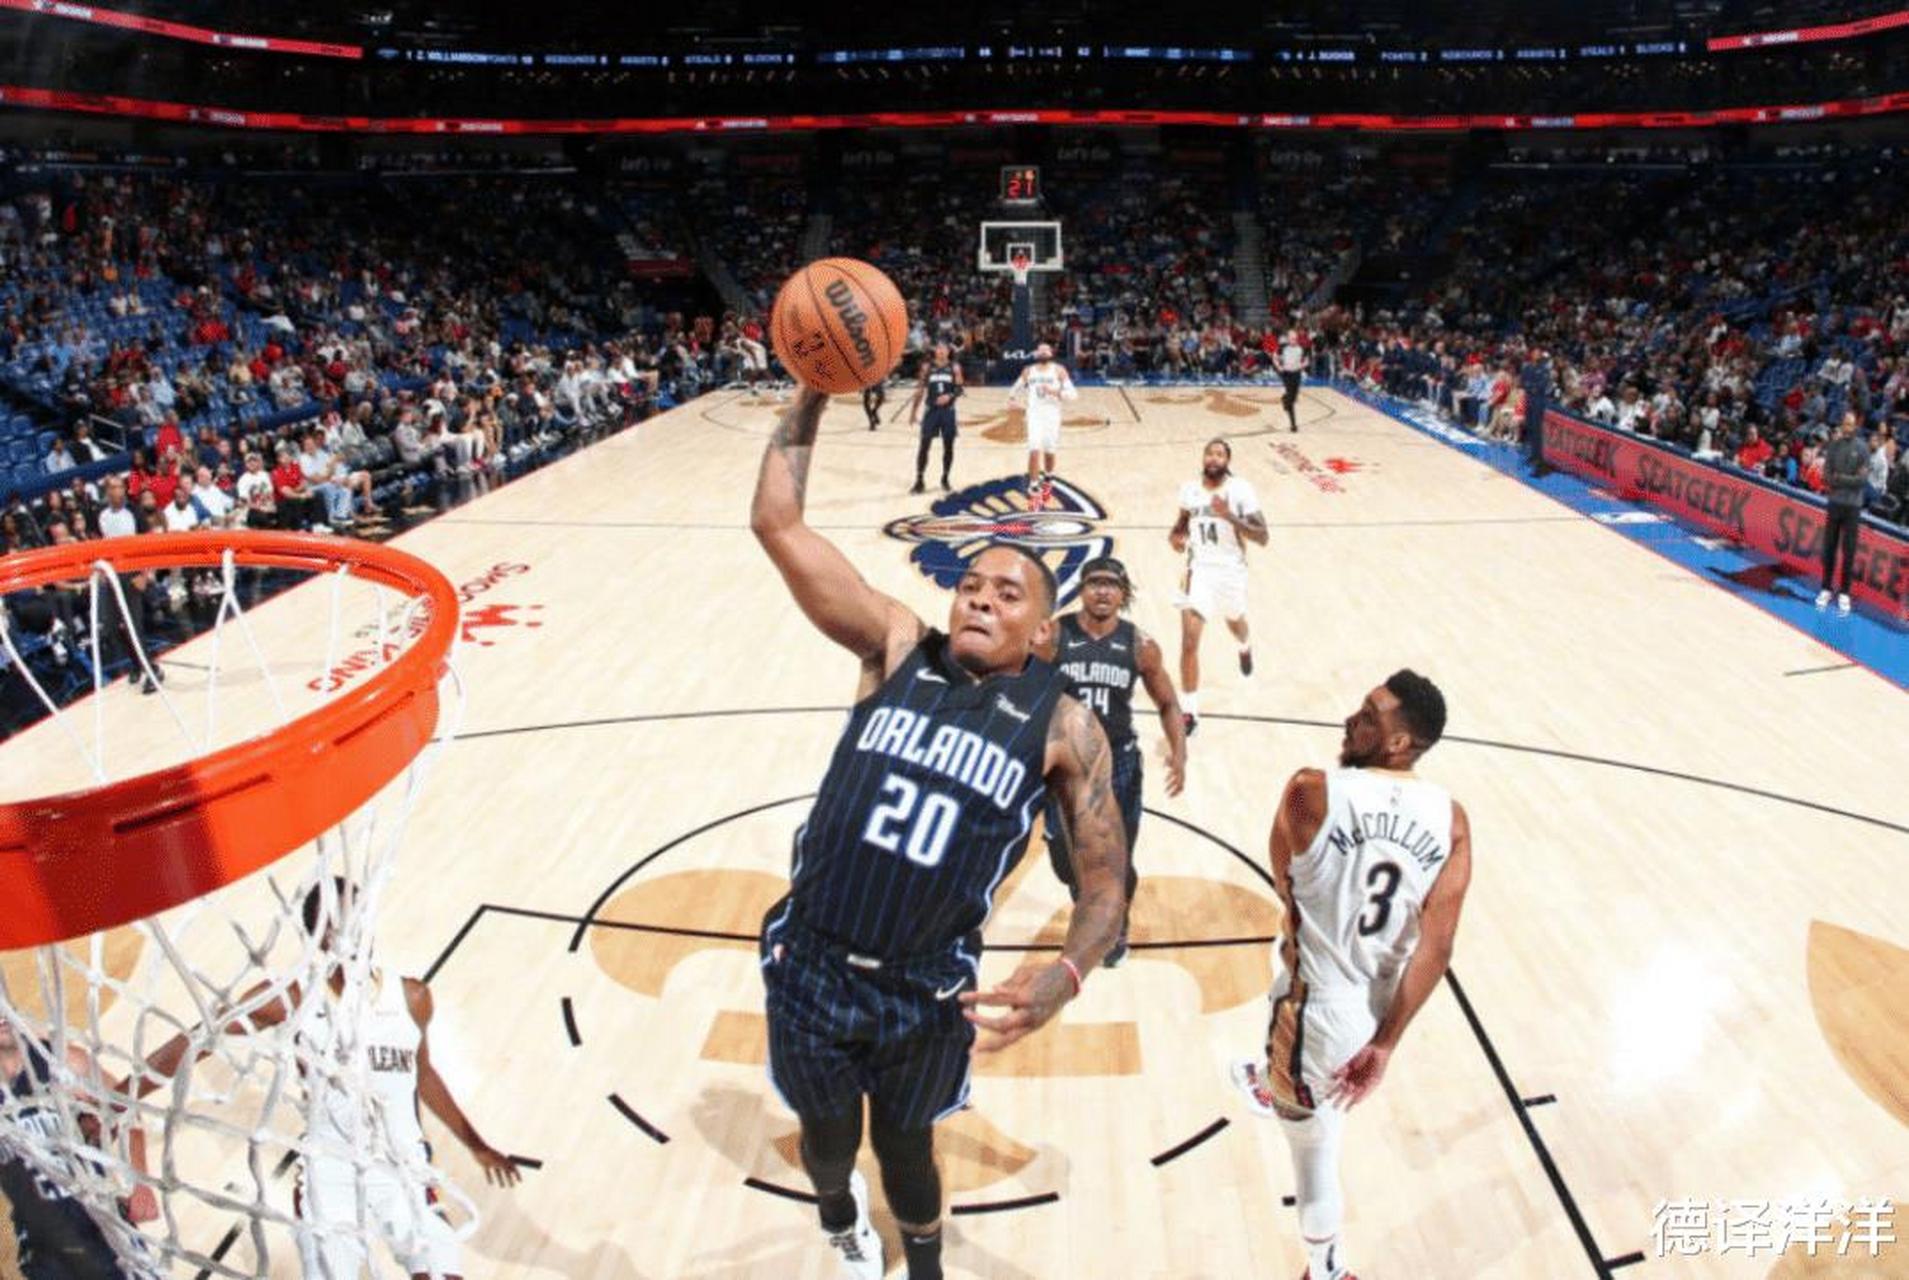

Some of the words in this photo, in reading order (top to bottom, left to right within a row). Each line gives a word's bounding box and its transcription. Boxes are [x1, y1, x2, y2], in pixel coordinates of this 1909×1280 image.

[1008, 179, 1033, 199] 21
[825, 279, 877, 369] Wilson
[1198, 521, 1219, 545] 14
[1636, 453, 1746, 538] SEATGEEK
[1775, 506, 1909, 600] SEAGEE
[1059, 661, 1131, 689] ORLANDO
[856, 706, 1027, 810] ORLANDO
[862, 772, 961, 868] 20
[1327, 812, 1445, 873] McCOLLUM
[1357, 860, 1403, 937] 3
